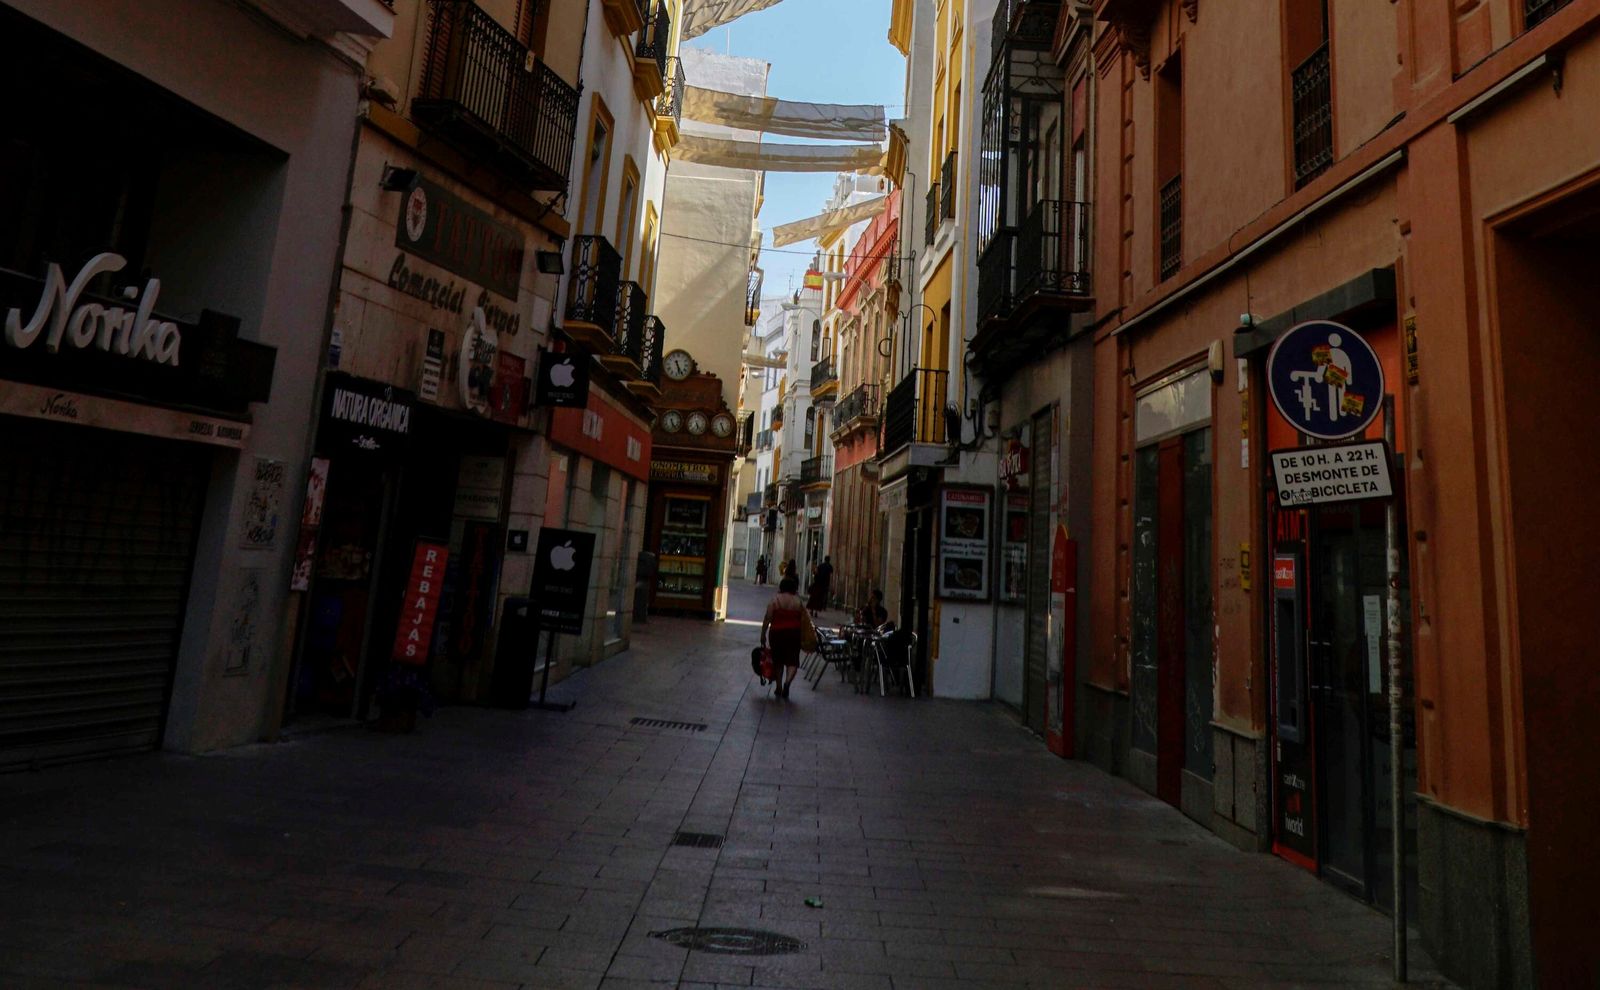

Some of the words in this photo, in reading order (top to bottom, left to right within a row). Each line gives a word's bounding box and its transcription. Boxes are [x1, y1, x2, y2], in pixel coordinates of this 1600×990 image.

[388, 253, 466, 314] Comercial
[5, 252, 182, 366] Norika
[41, 394, 78, 417] Norika
[331, 387, 368, 425] NATURA
[1280, 457, 1298, 469] DE
[1301, 455, 1316, 467] 10
[1334, 453, 1344, 464] A
[1347, 451, 1363, 462] 22
[1284, 467, 1359, 485] DESMONTE
[1361, 464, 1380, 477] DE
[1312, 482, 1379, 498] BICICLETA
[405, 549, 437, 656] REBAJAS
